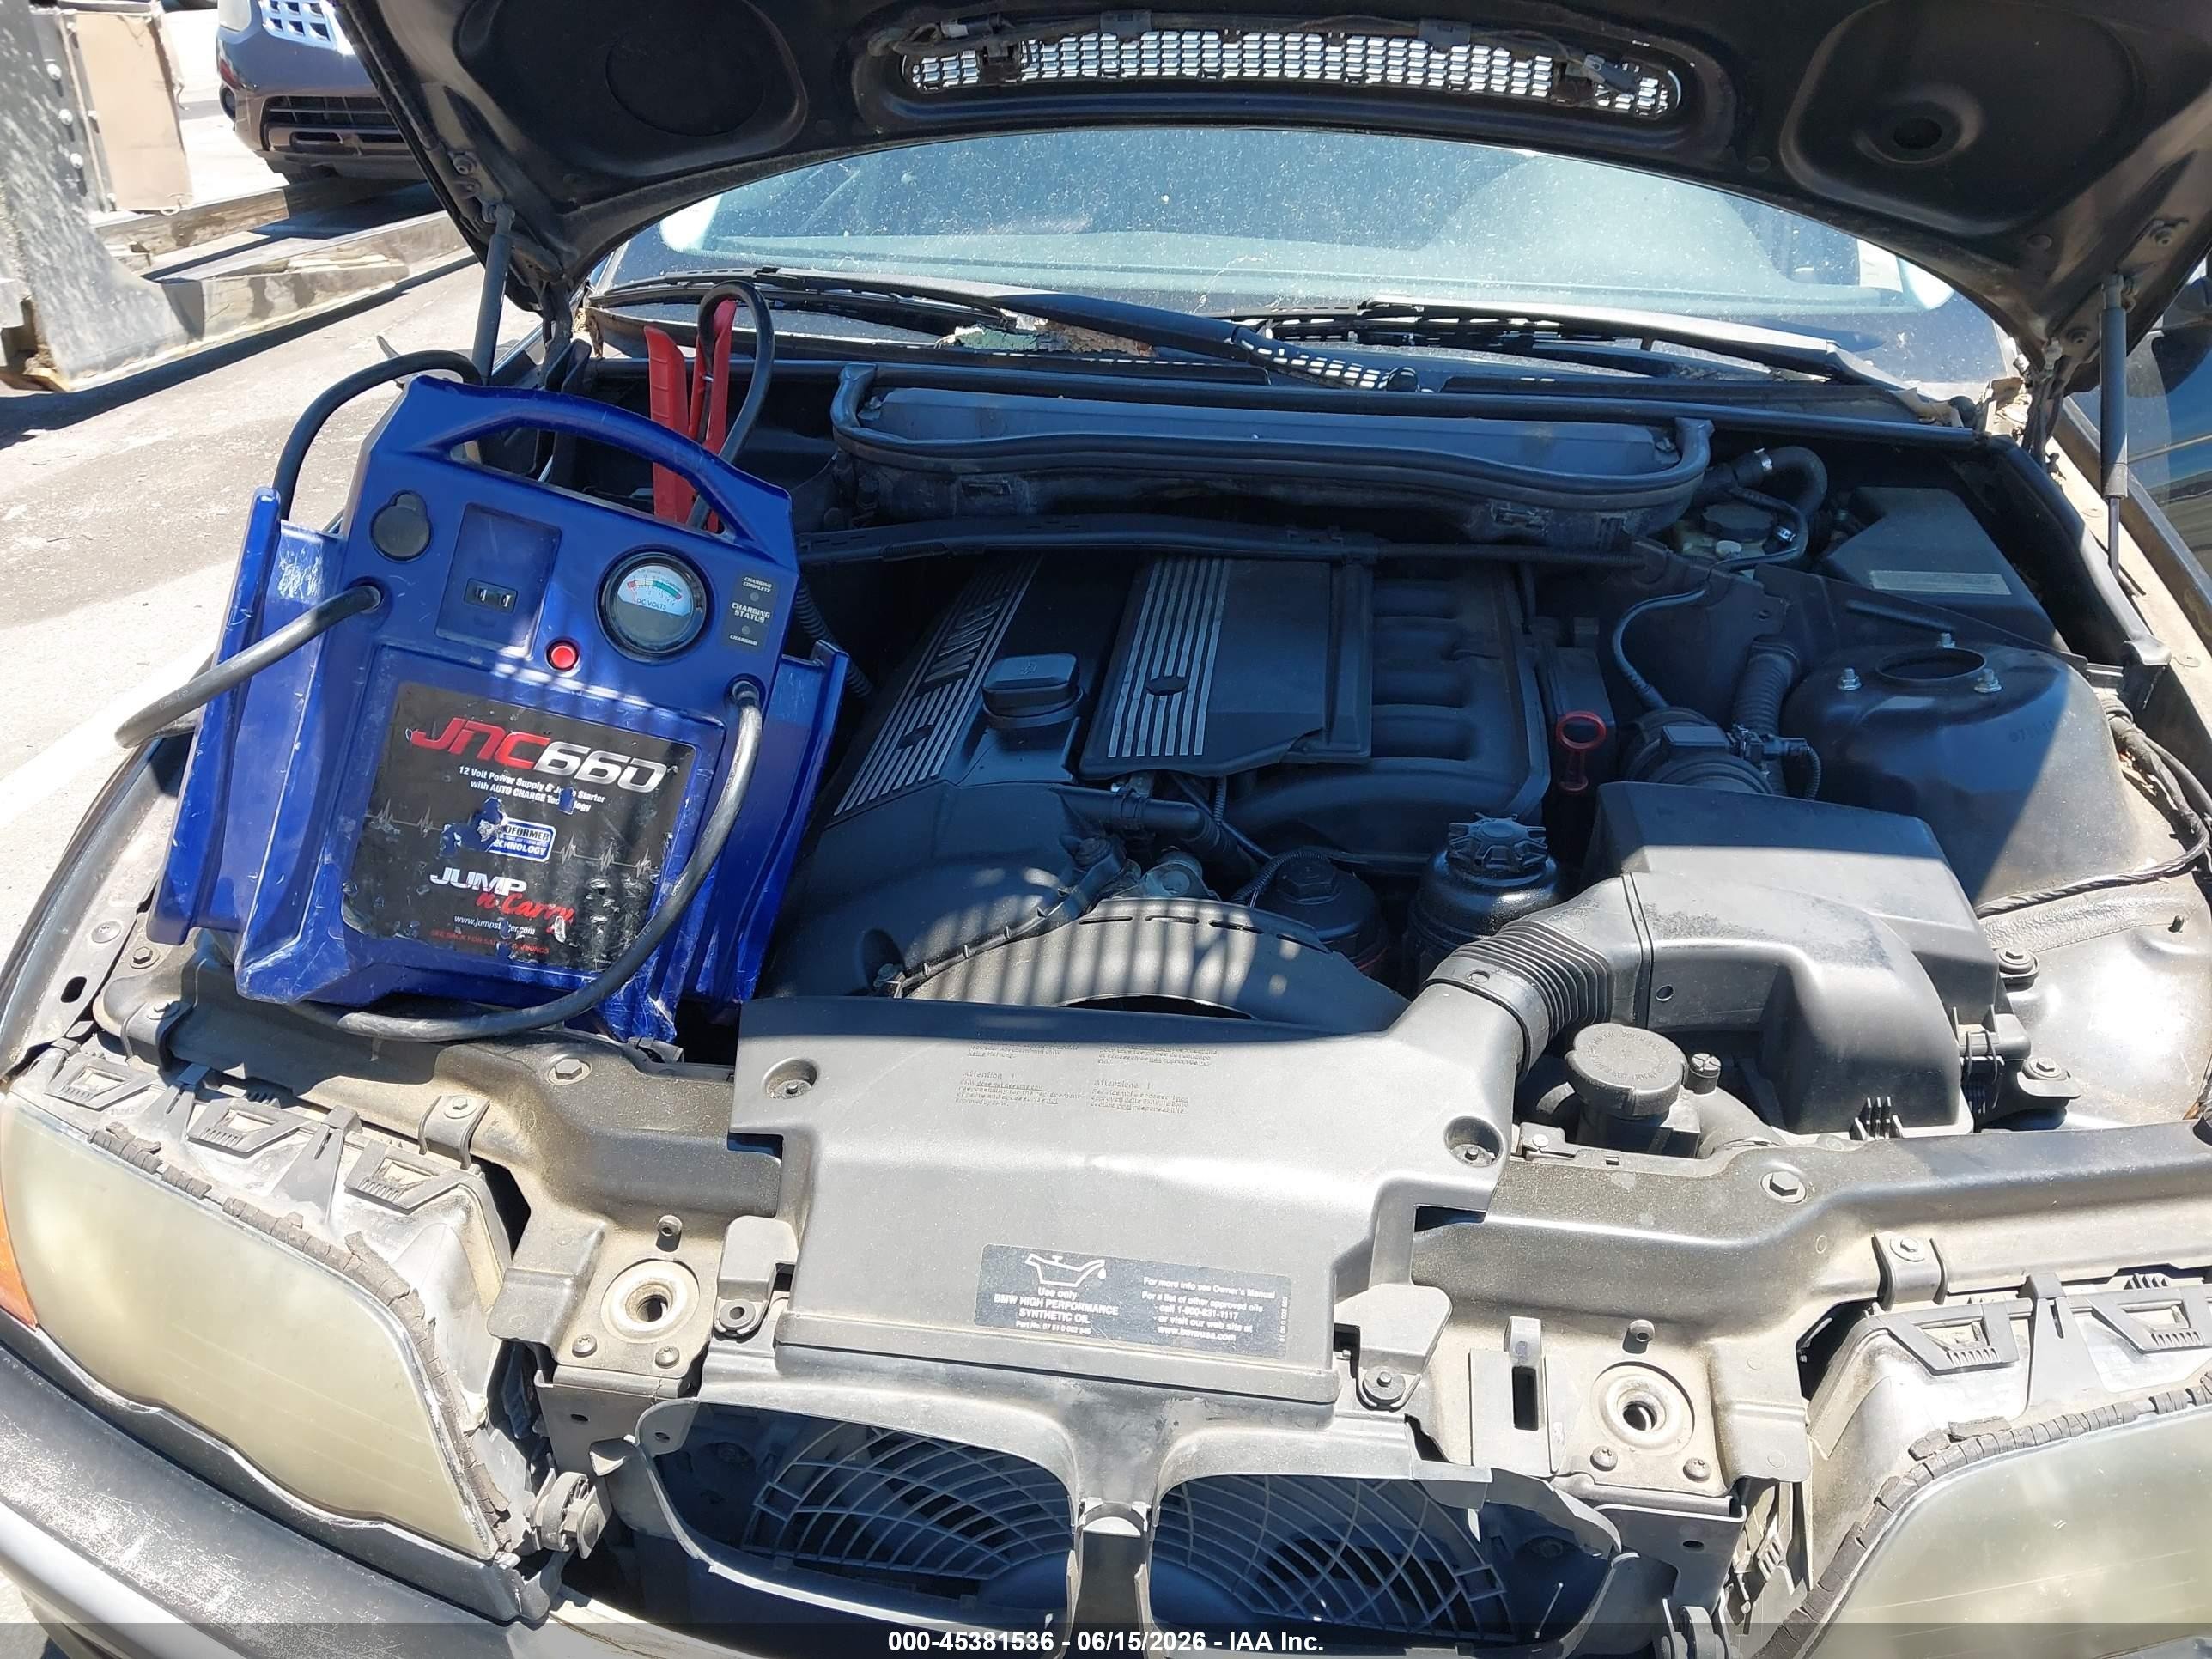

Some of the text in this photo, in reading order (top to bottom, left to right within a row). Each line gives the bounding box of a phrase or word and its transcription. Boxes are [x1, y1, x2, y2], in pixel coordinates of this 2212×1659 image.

[647, 600, 667, 611] VOLTS
[732, 602, 771, 619] CHARGING
[734, 609, 765, 623] STATUS
[459, 765, 470, 775] 12
[471, 768, 488, 779] Volt
[489, 772, 515, 785] Power
[516, 777, 545, 793] Supply
[545, 782, 555, 793] &
[578, 790, 606, 804] Starter
[470, 781, 489, 791] with
[490, 784, 512, 797] AUTO
[513, 788, 545, 803] CHARGE
[429, 866, 527, 896] JUMP
[1038, 1287, 1078, 1300] Use only
[1143, 1277, 1158, 1286] For
[1158, 1279, 1179, 1289] more
[1180, 1280, 1196, 1291] info
[1247, 1288, 1276, 1299] Manual
[994, 1293, 1120, 1316] BMW HIGH PERFORMANCE
[1141, 1291, 1156, 1300] For
[1164, 1293, 1176, 1303] list
[1177, 1295, 1187, 1304] of
[1188, 1296, 1209, 1306] other
[1210, 1299, 1248, 1311] approved
[1159, 1304, 1176, 1314] call
[1016, 1320, 1030, 1328] Part
[1018, 1308, 1091, 1324] SYNTHETIC OIL
[1158, 1315, 1168, 1323] or
[1170, 1316, 1188, 1326] visit
[1189, 1318, 1206, 1327] our
[1206, 1320, 1225, 1330] web
[1225, 1322, 1243, 1333] site
[1158, 1325, 1237, 1342] www.bmwusa.com
